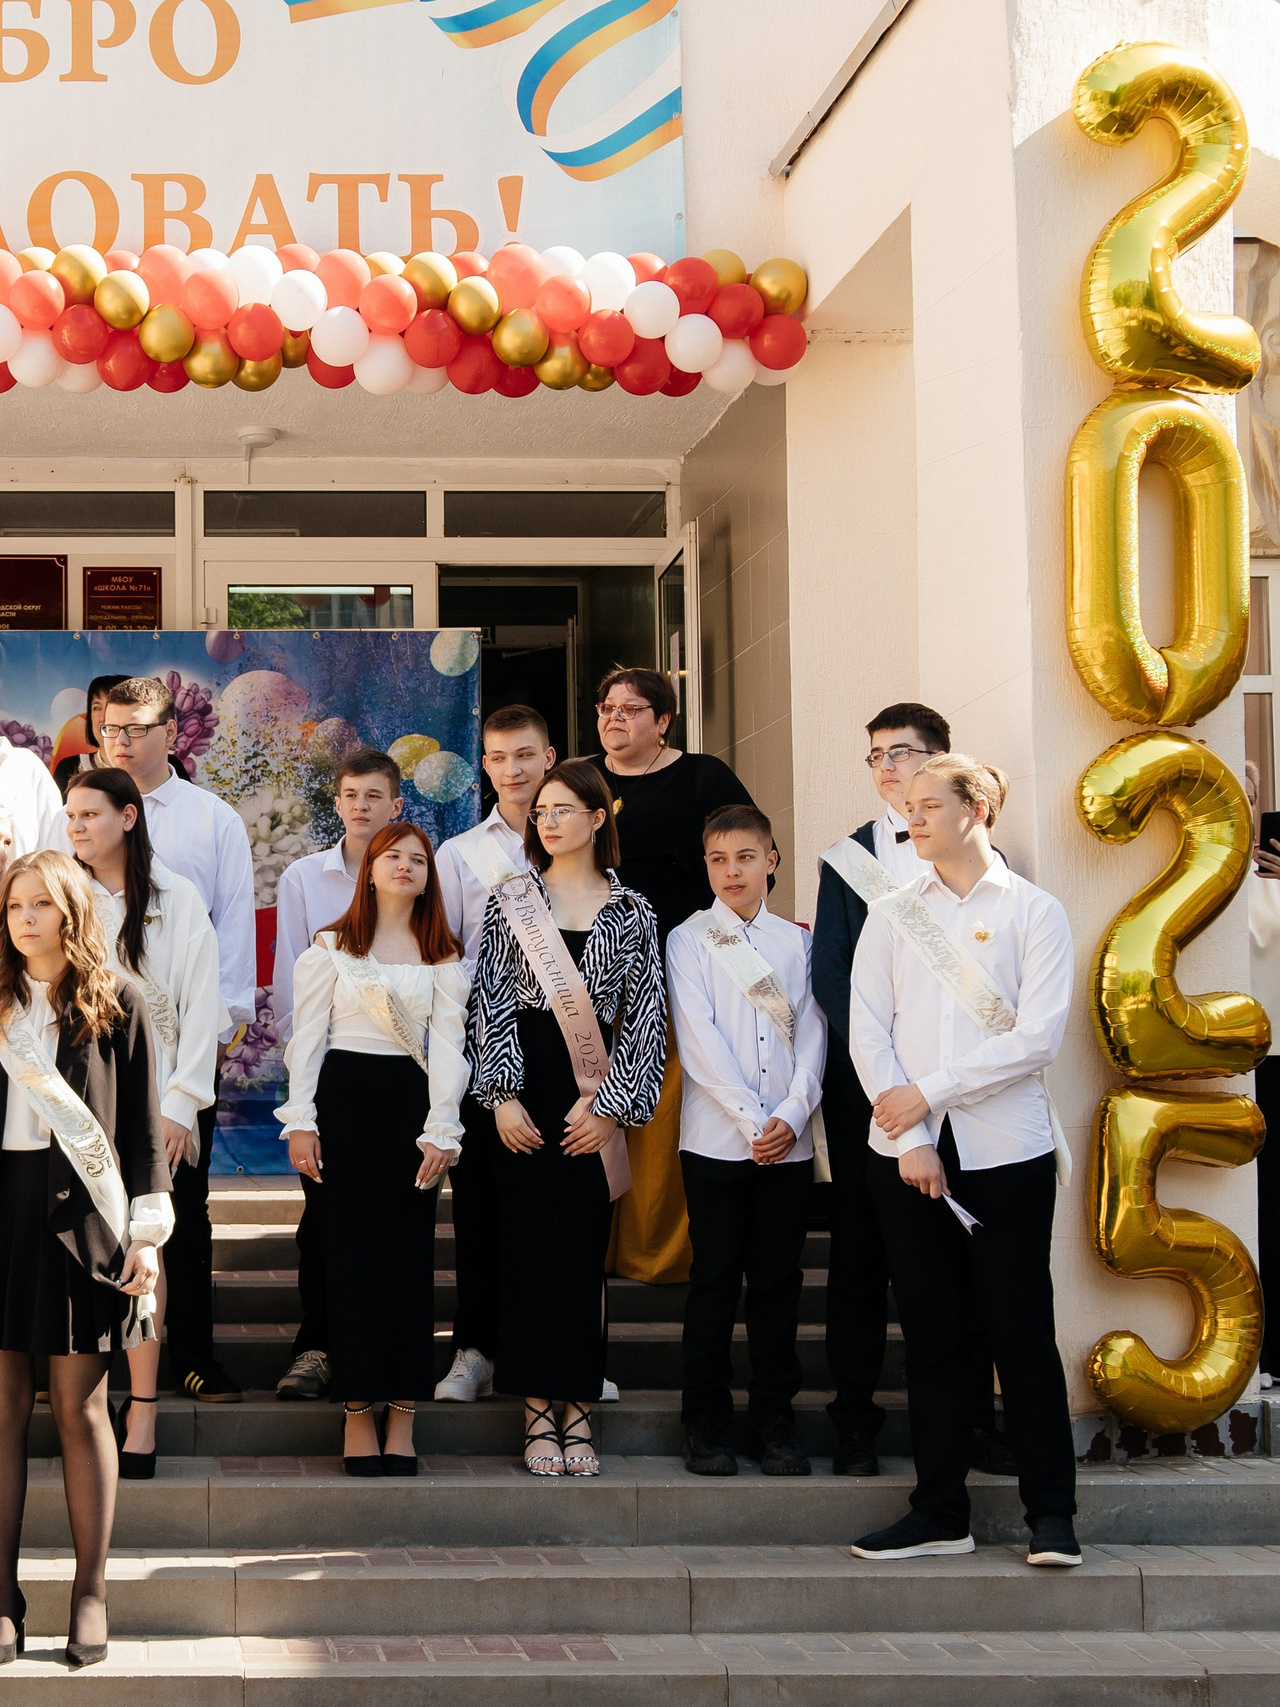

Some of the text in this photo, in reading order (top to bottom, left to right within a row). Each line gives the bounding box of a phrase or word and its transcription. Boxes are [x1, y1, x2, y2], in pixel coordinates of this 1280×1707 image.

[94, 584, 127, 592] «ШКОЛА
[515, 901, 603, 1080] Выпускница 2025
[148, 993, 179, 1047] 2025
[975, 997, 1016, 1036] 202
